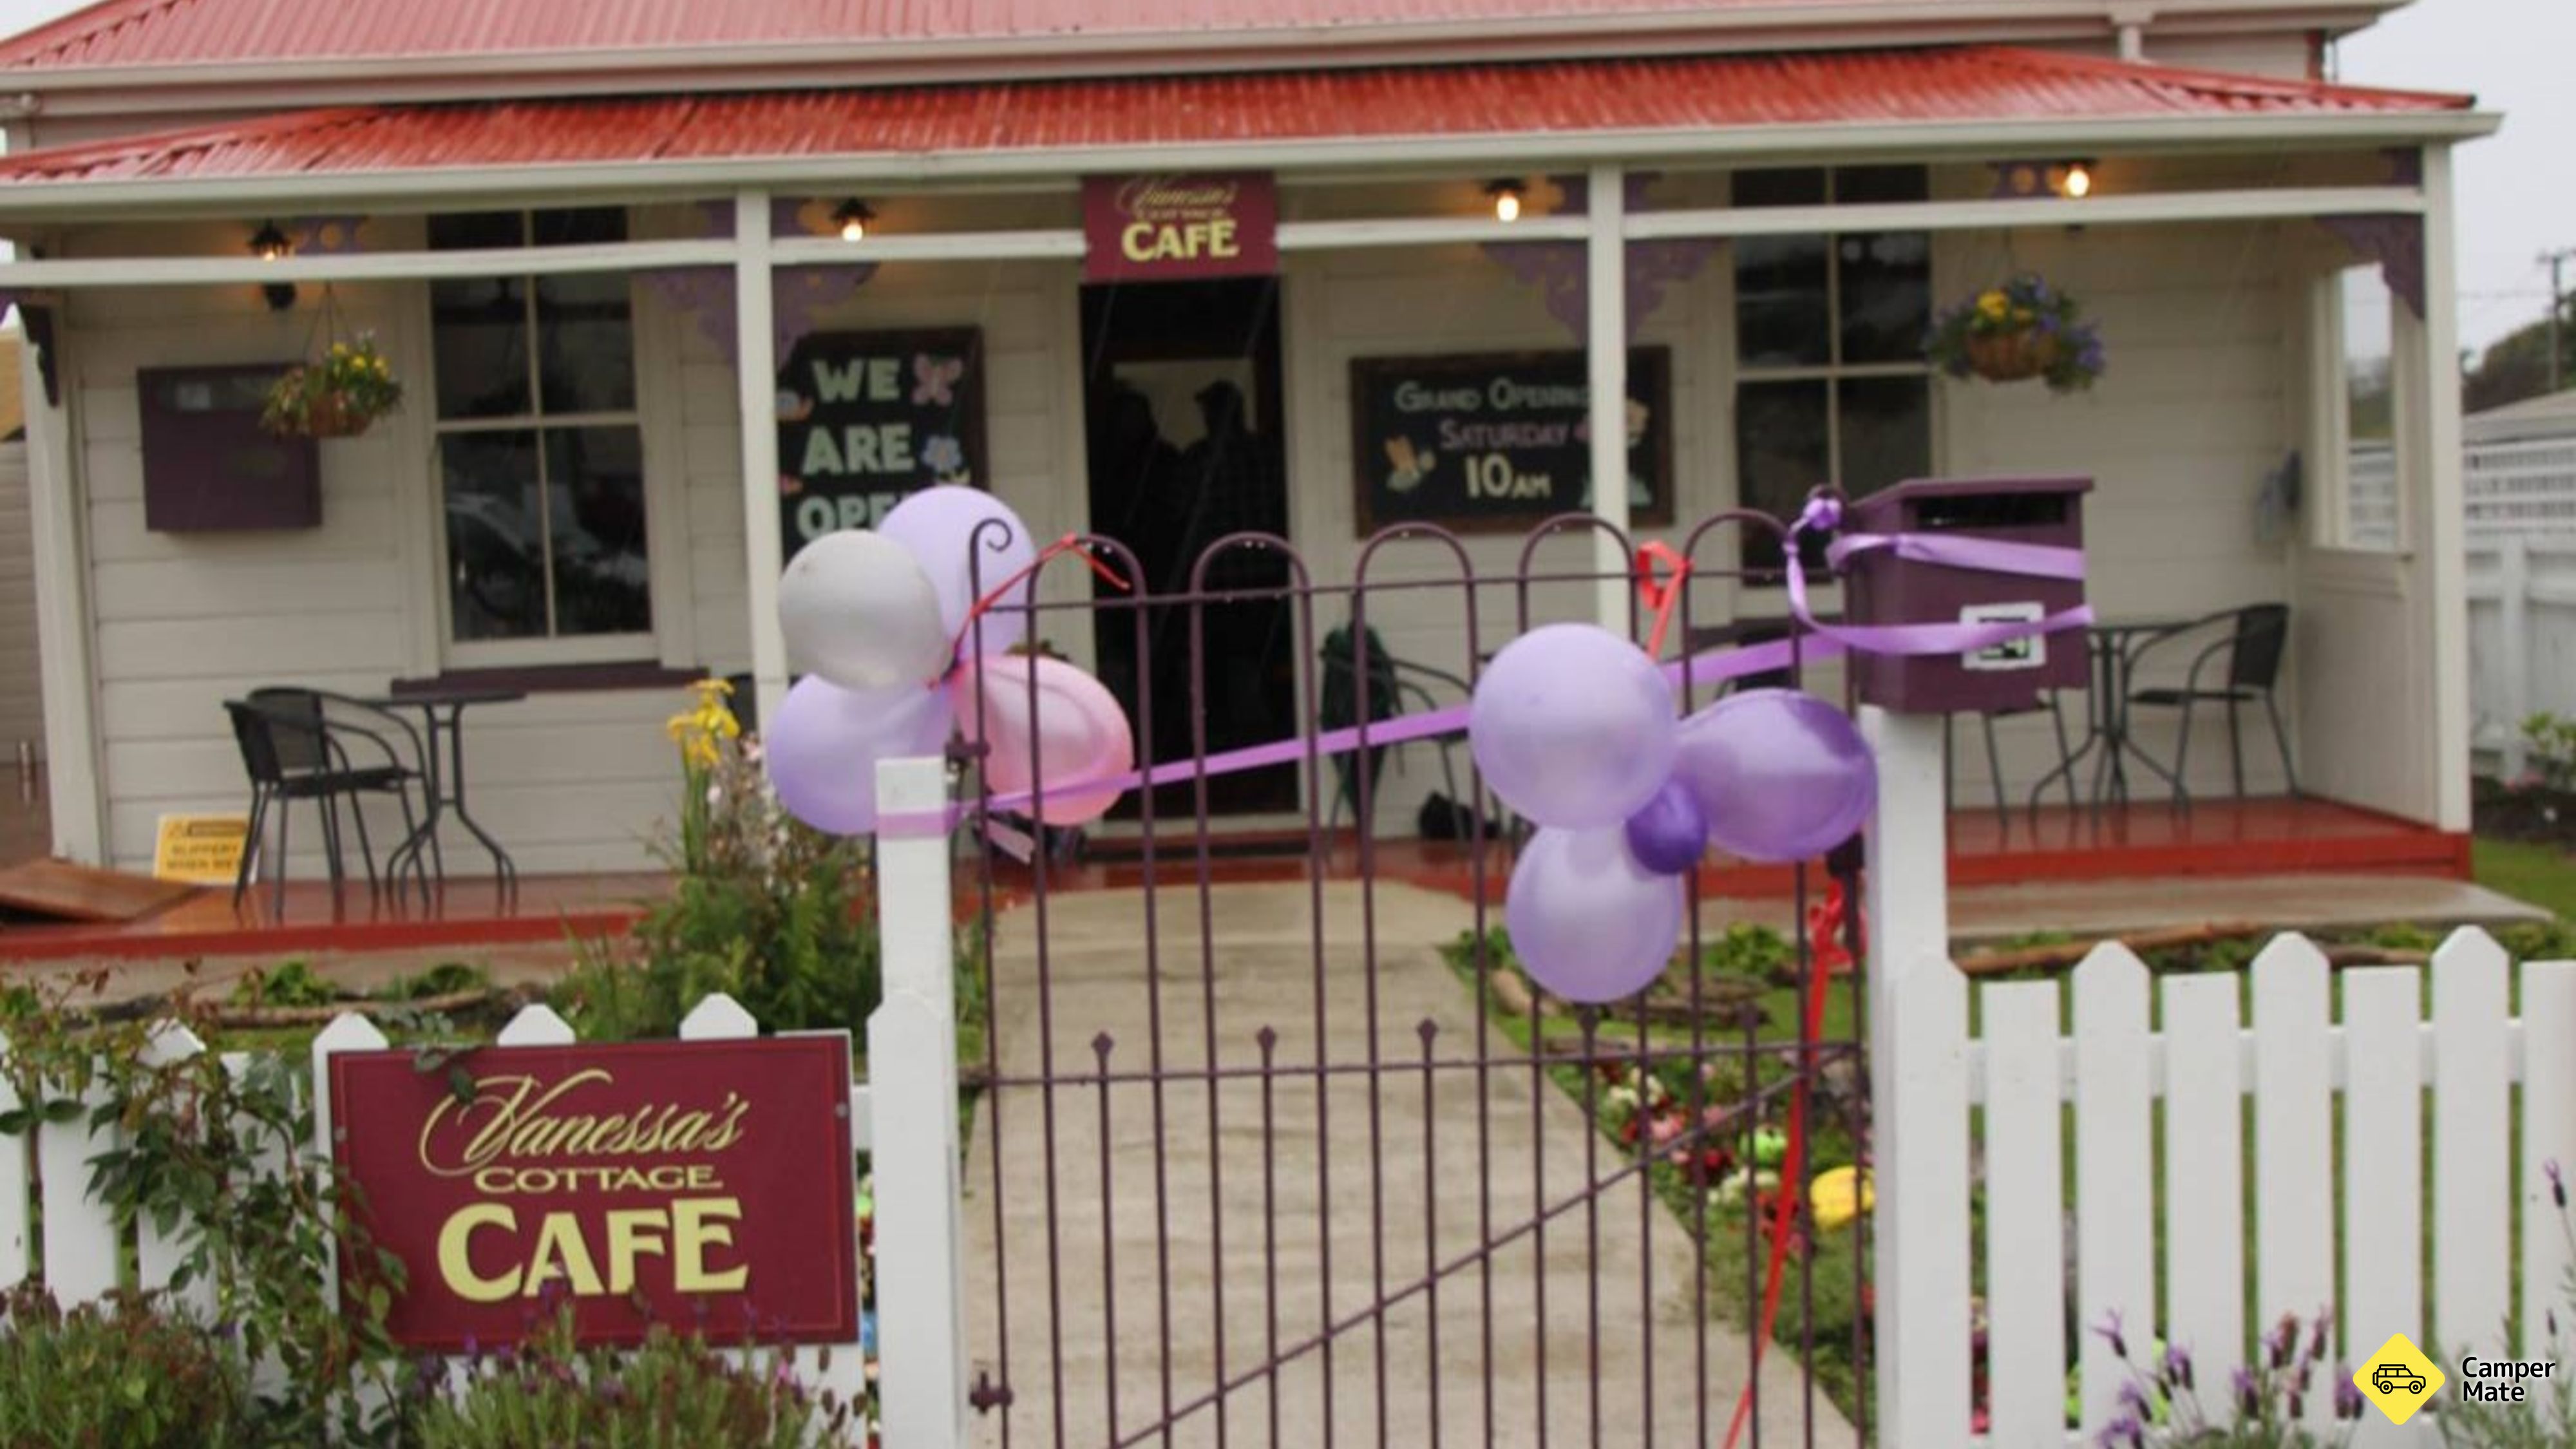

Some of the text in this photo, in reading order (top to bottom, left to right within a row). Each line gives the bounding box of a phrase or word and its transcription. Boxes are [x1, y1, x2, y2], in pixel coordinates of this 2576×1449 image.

[1121, 220, 1240, 261] CAFE
[811, 358, 901, 403] WE
[802, 423, 914, 475] ARE
[796, 492, 911, 541] OPE
[419, 1068, 750, 1177] Vanessa's
[475, 1165, 723, 1193] COTTAGE
[437, 1197, 750, 1303] CAFE
